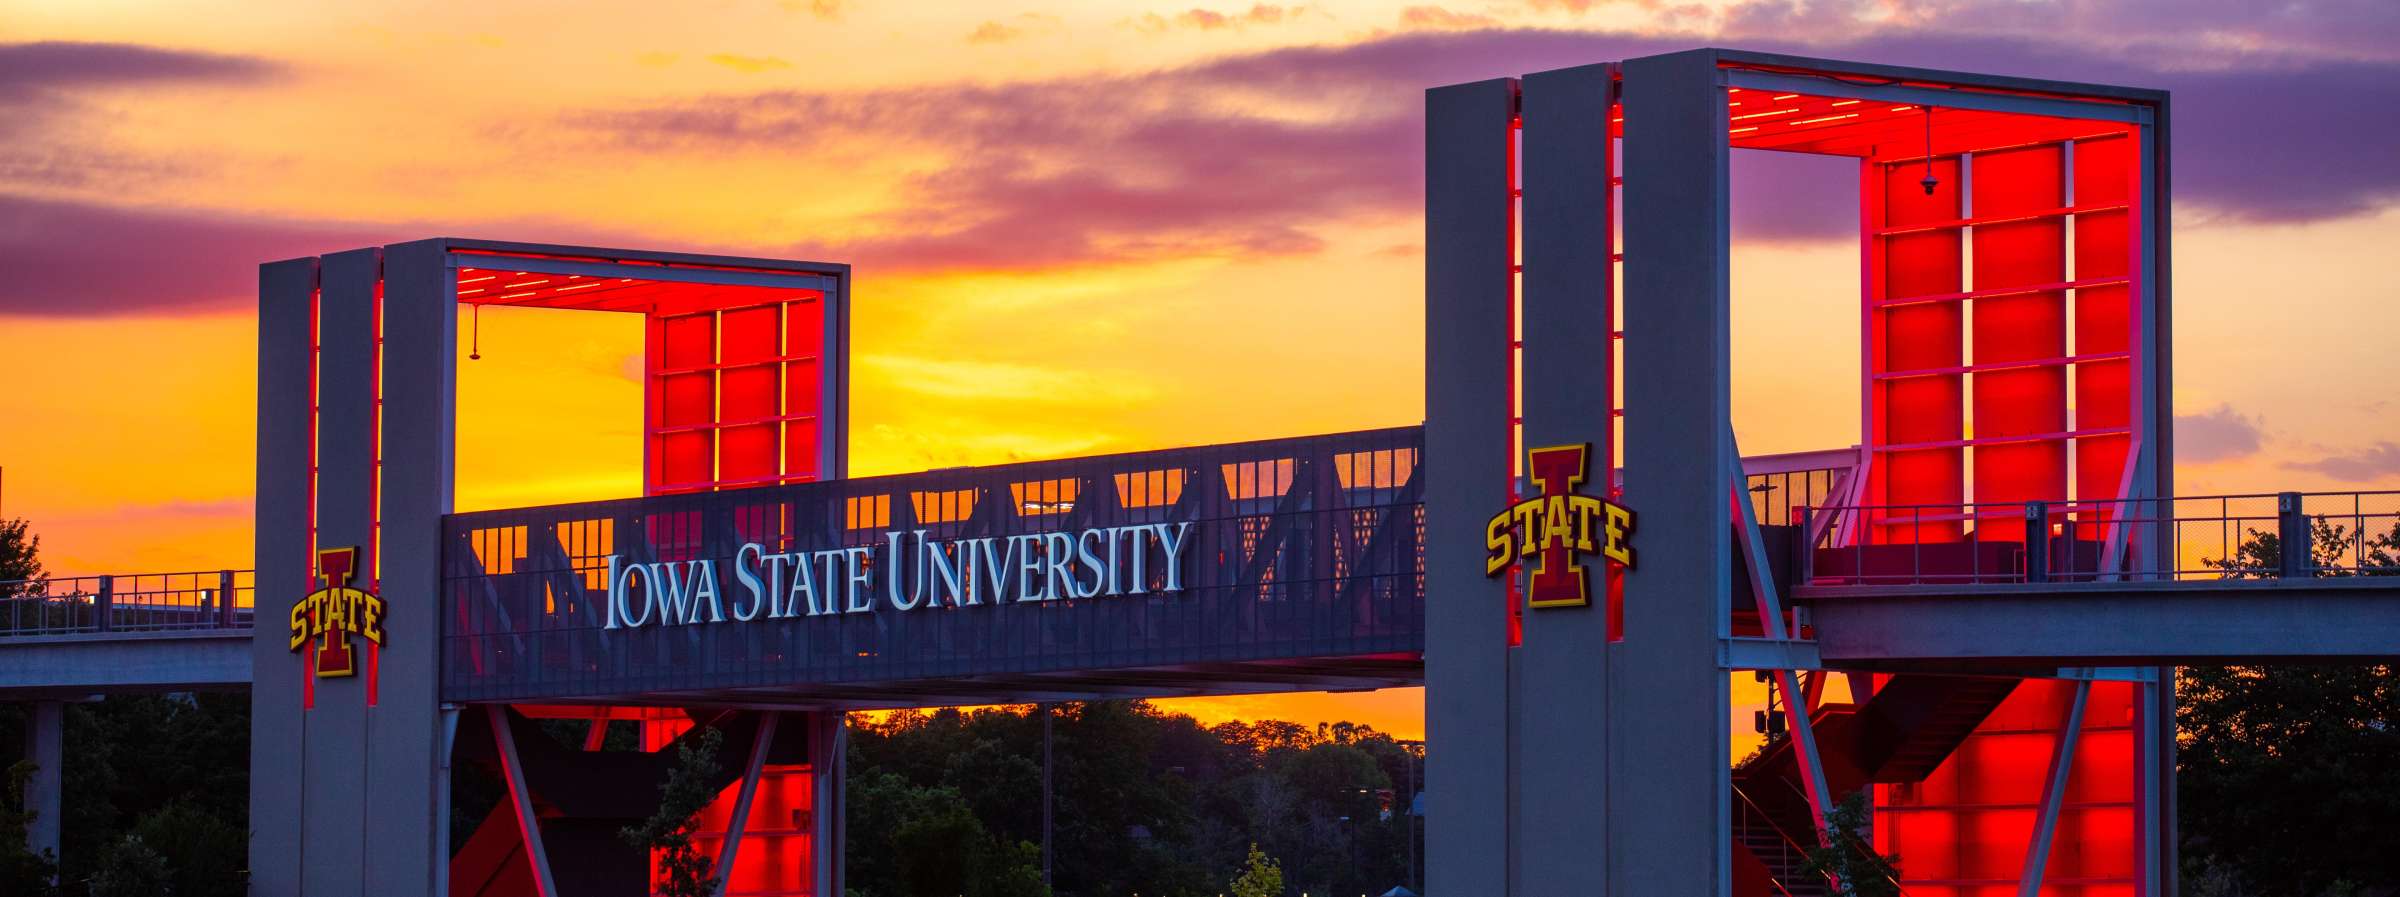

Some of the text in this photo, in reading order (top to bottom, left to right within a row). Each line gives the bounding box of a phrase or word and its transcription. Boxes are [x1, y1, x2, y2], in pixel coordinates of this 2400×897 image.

[604, 522, 1191, 630] IOWA STATE UNIVERSITY
[1487, 495, 1630, 575] STATE
[1528, 444, 1586, 608] I
[290, 588, 381, 650] STATE
[316, 547, 354, 677] I
